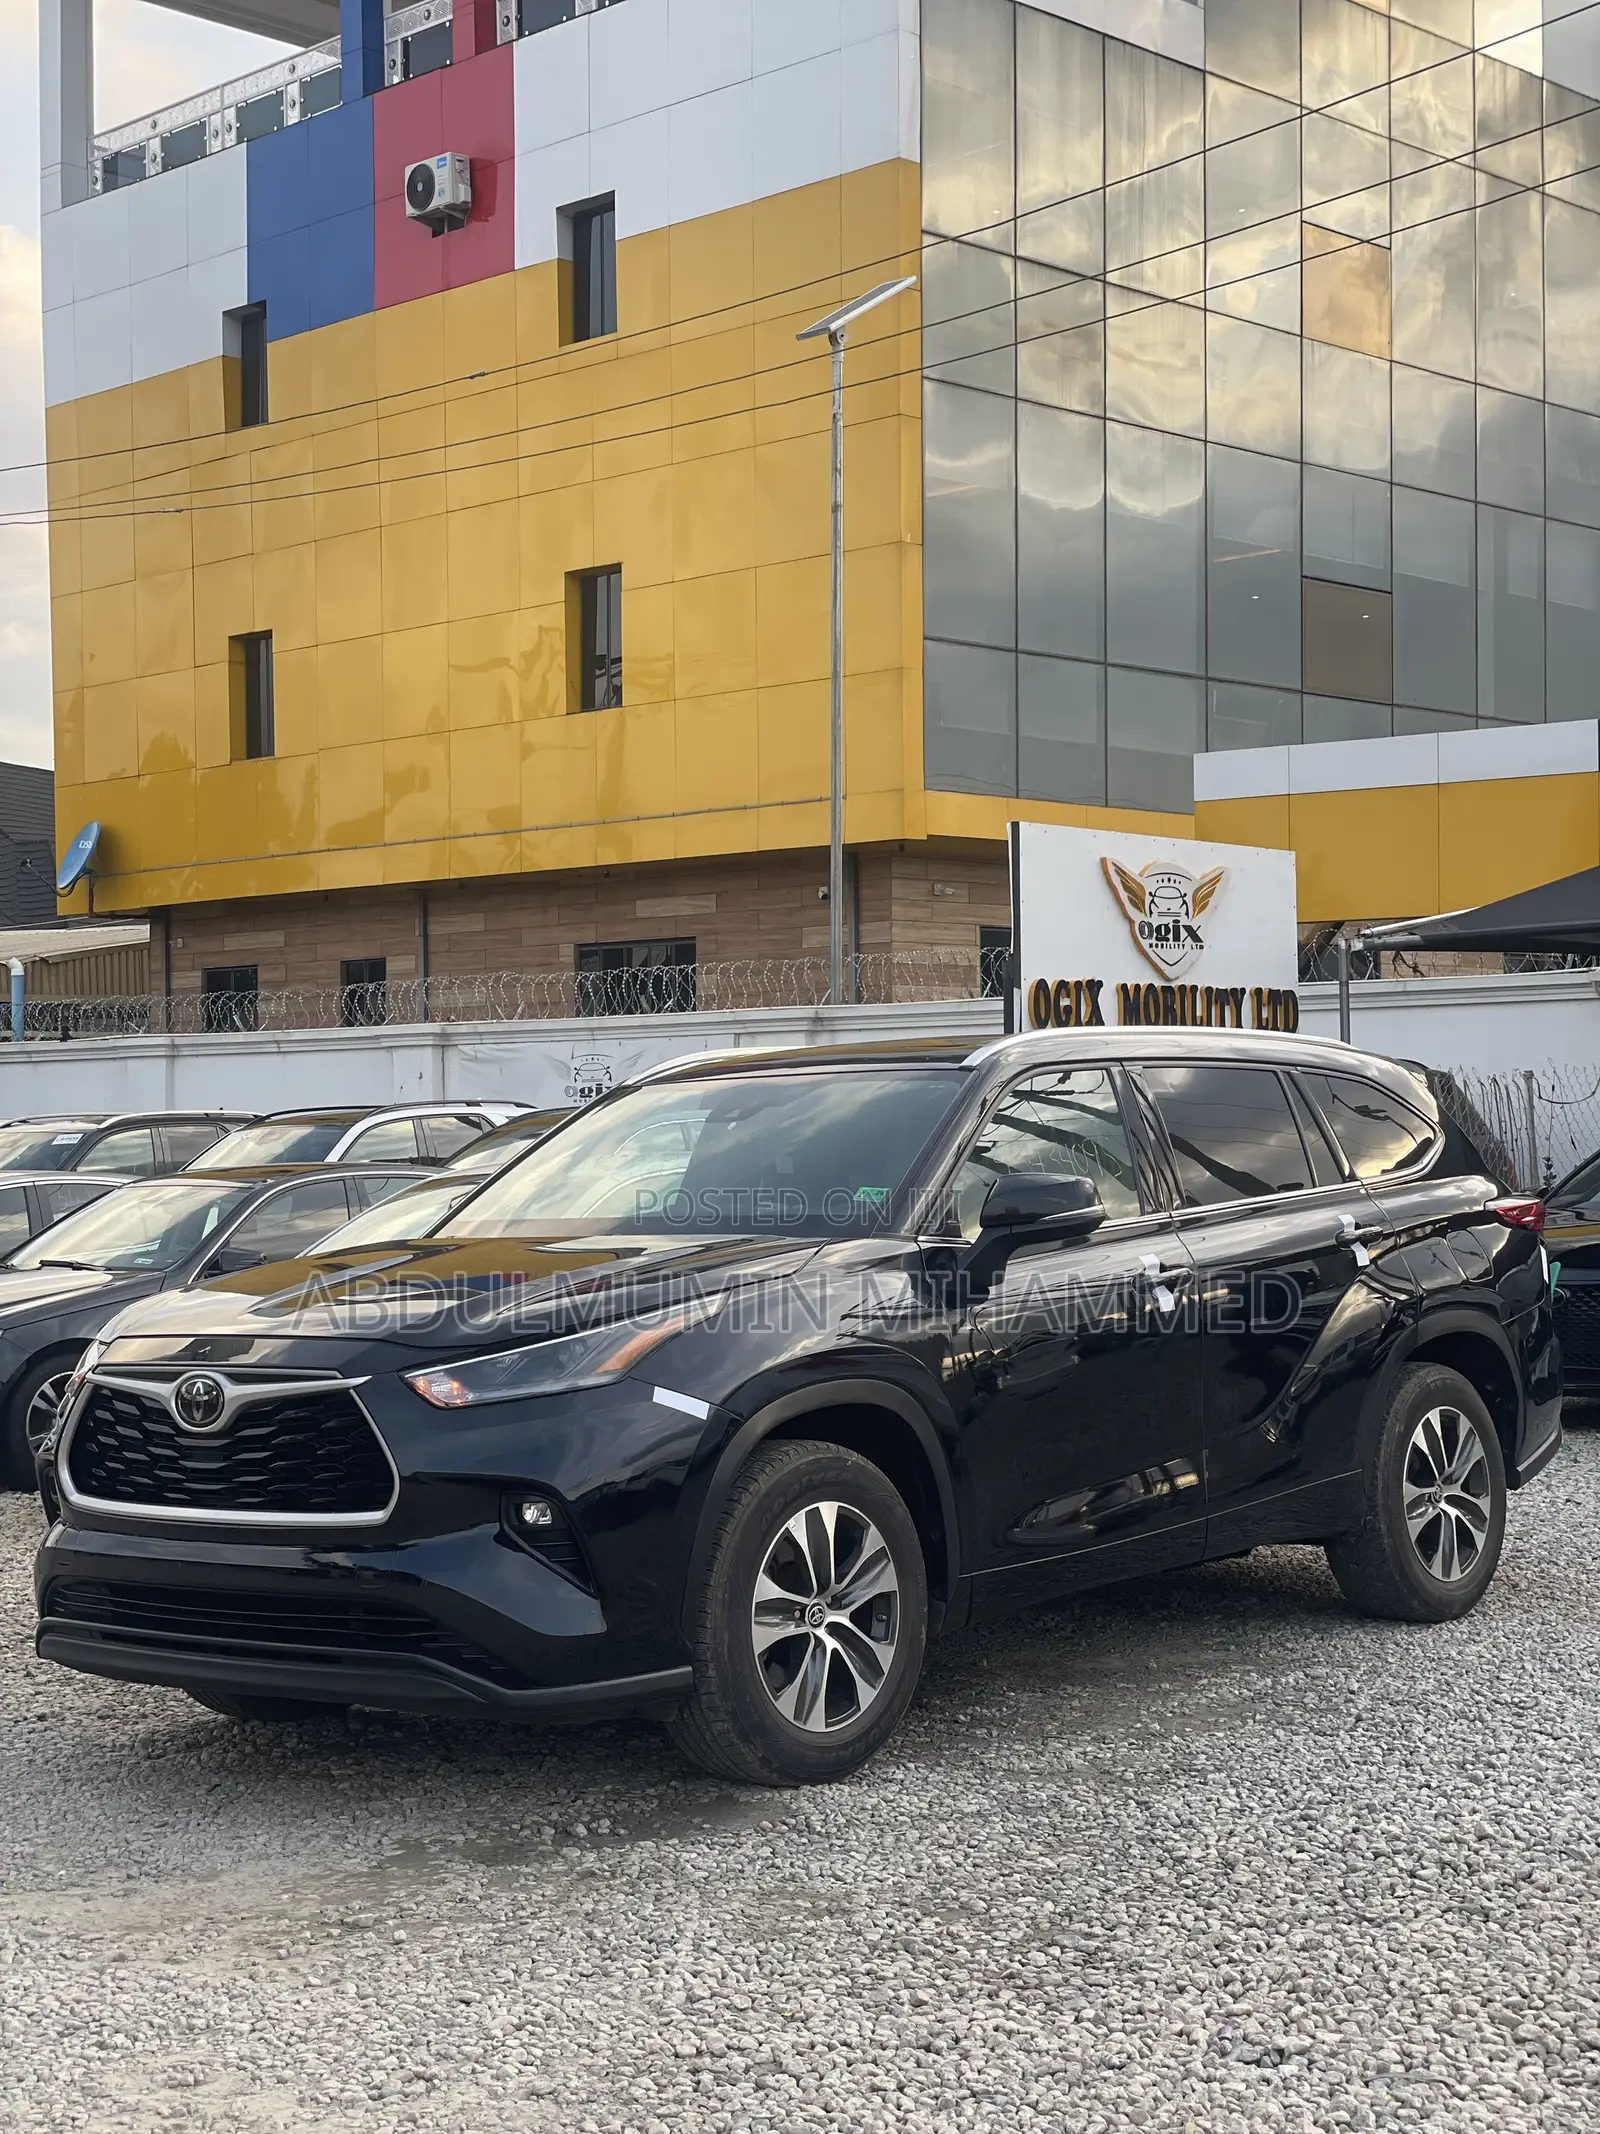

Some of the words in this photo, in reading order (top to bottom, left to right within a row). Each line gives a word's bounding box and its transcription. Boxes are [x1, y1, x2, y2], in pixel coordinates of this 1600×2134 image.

[1028, 978, 1105, 1029] OGIX
[1116, 983, 1246, 1028] MOBILITY
[1250, 987, 1299, 1033] LTD
